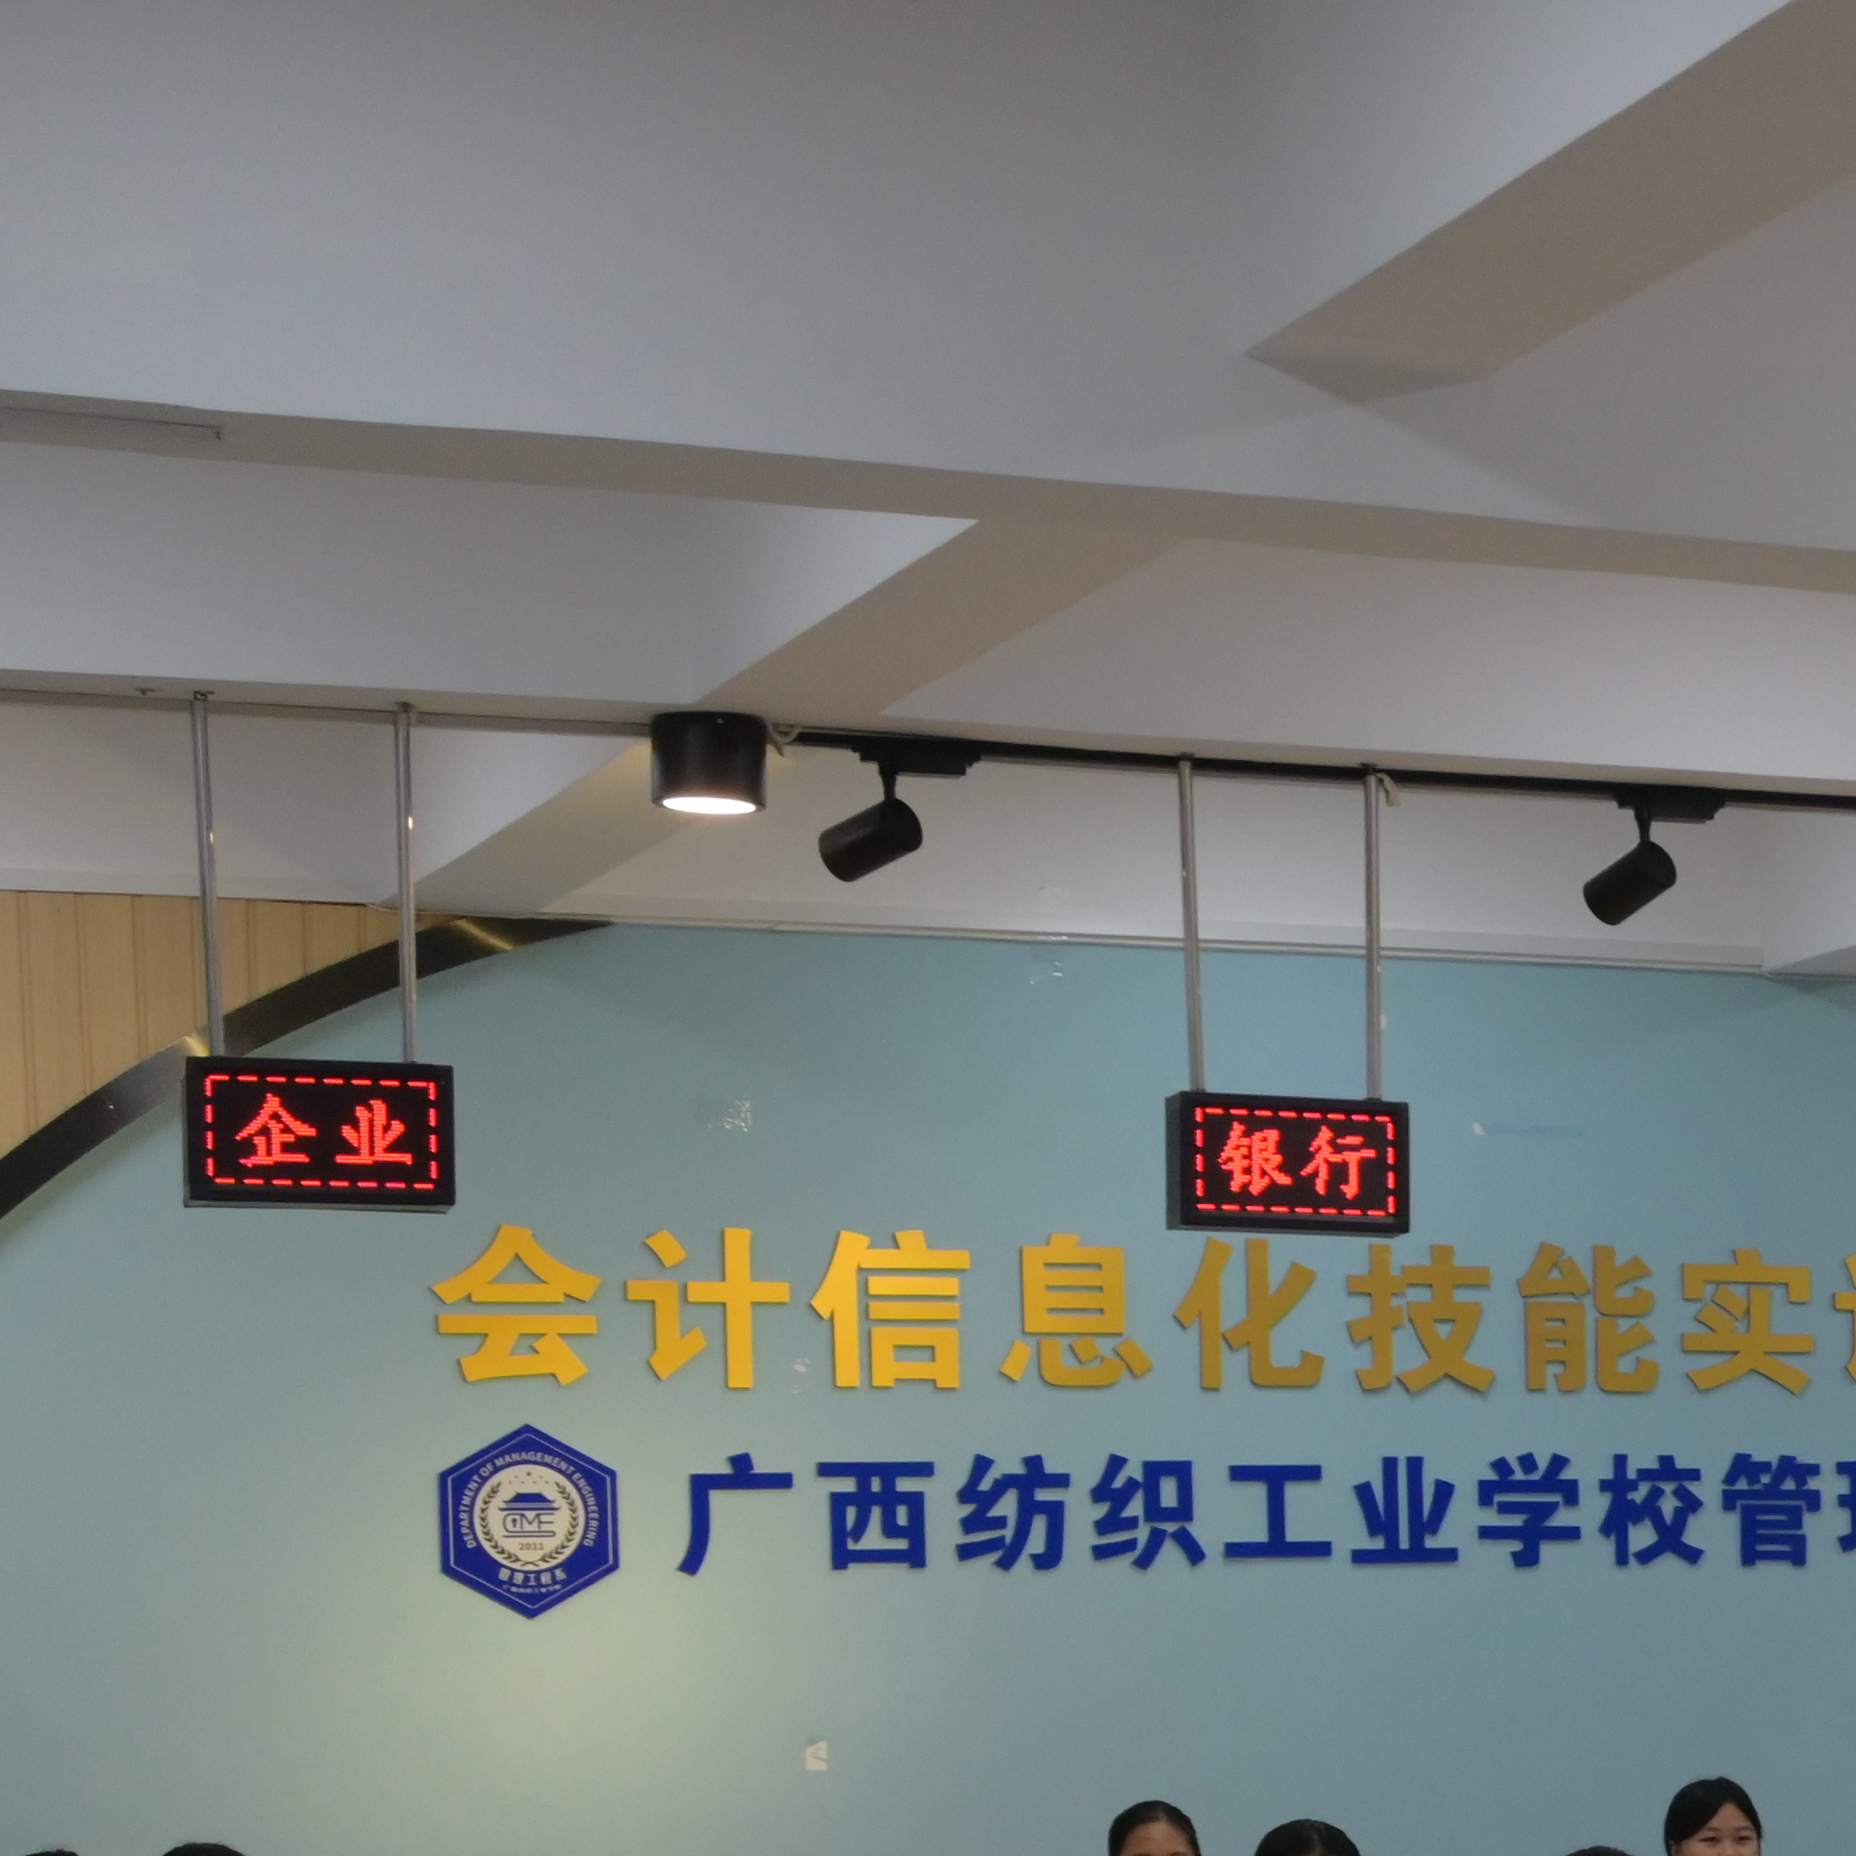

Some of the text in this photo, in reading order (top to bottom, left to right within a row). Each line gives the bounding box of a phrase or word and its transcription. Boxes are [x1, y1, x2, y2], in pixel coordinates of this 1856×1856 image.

[235, 1093, 413, 1168] 企业
[1218, 1121, 1378, 1199] 银行
[459, 1476, 485, 1549] DEPARTMENT
[495, 1451, 574, 1476] MANAGEMENT
[571, 1472, 600, 1548] ENGINEERING
